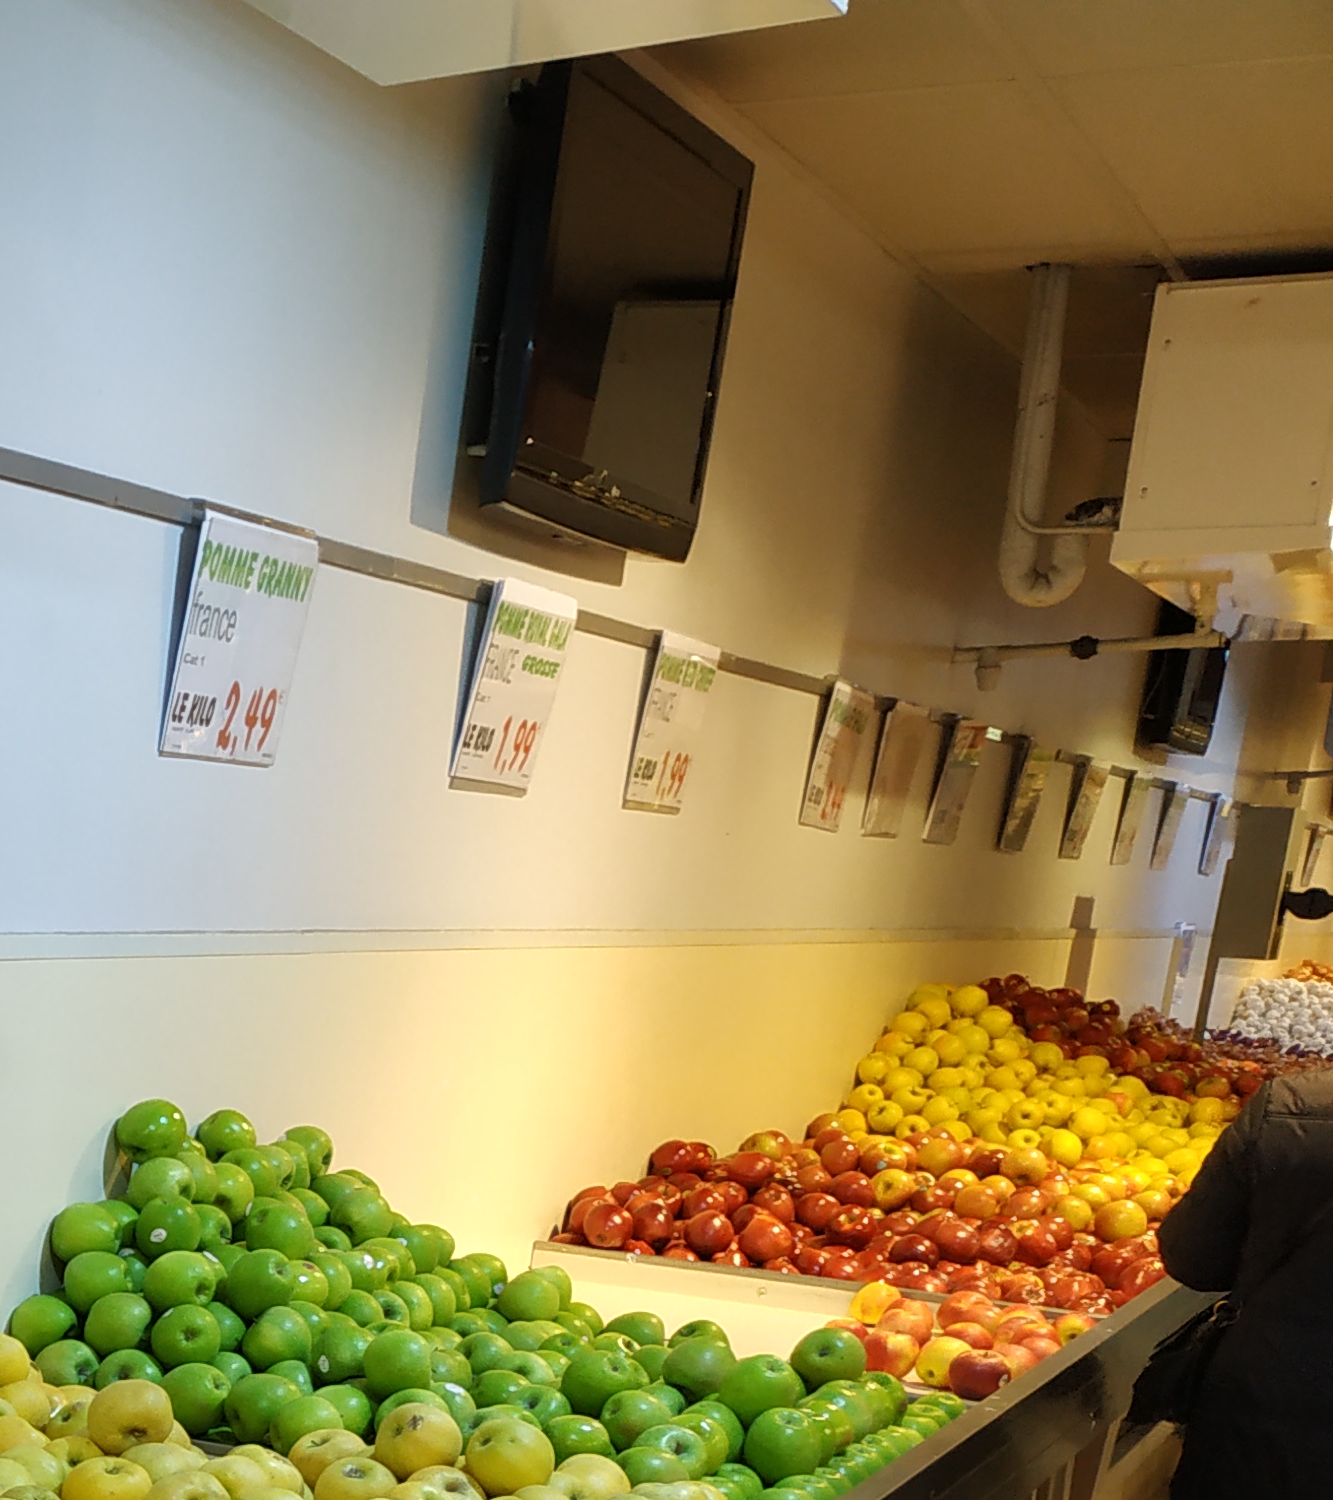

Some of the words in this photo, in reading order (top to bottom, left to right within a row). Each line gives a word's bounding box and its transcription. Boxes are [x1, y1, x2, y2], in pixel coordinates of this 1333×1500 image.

[198, 539, 259, 590] POMME
[256, 554, 314, 603] GRANNY
[522, 654, 560, 679] GROSSE
[171, 691, 190, 724] LE
[187, 693, 217, 728] KILO
